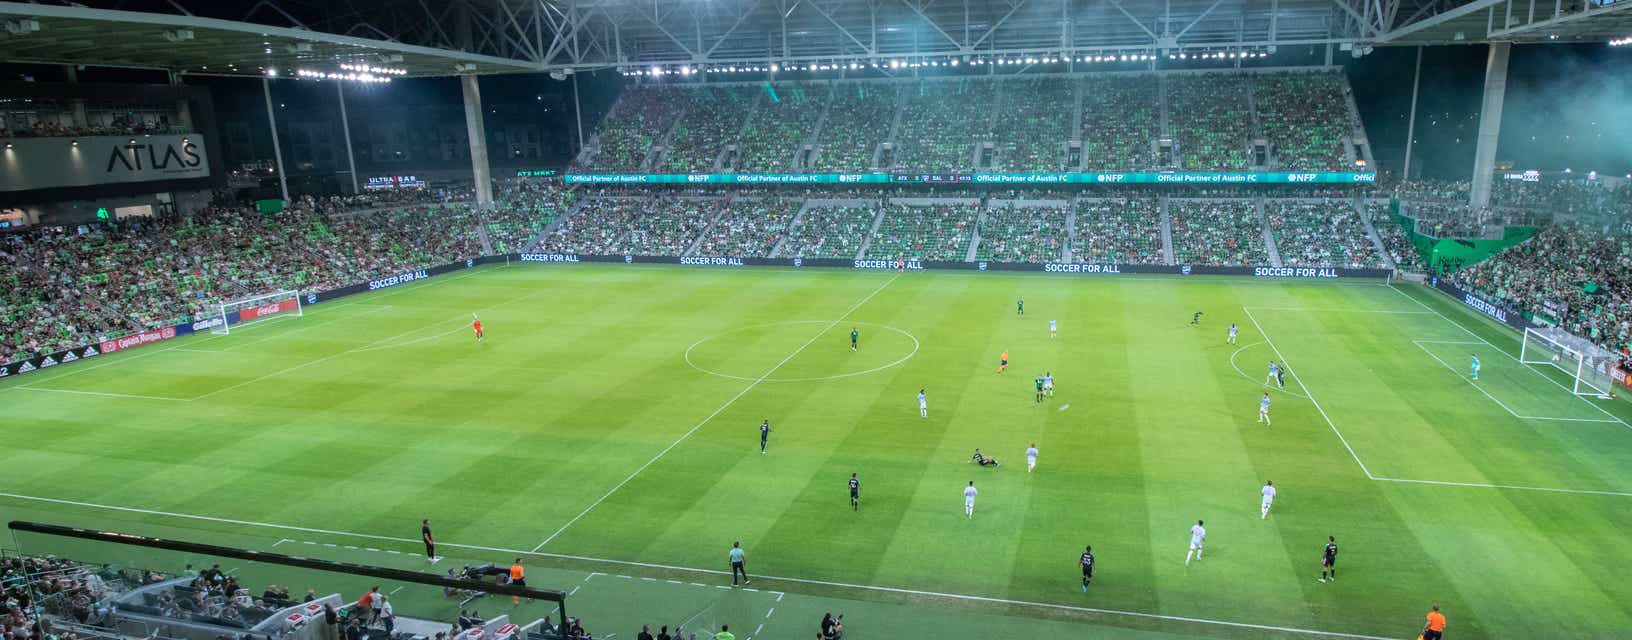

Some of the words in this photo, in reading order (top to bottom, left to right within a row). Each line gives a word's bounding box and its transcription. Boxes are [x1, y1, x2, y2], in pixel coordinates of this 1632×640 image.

[107, 143, 201, 172] ATLAS
[1158, 174, 1183, 182] Official
[1185, 174, 1211, 182] Partner
[1212, 174, 1221, 182] of
[1221, 174, 1246, 182] Austin
[1247, 174, 1257, 182] FC
[1297, 174, 1317, 182] NFP
[521, 253, 548, 261] SOCCER
[549, 254, 564, 262] FOR
[565, 254, 580, 262] ALL
[711, 257, 727, 265] FOR
[854, 260, 887, 268] SOCCER
[907, 261, 923, 269] ALL
[1045, 264, 1080, 272] SOCCER
[1082, 264, 1101, 272] FOR
[1102, 264, 1121, 273] ALL
[1255, 267, 1294, 276] SOCCER
[1295, 268, 1316, 277] FOR
[1318, 268, 1338, 277] ALL
[369, 276, 399, 290] SOCCER
[399, 272, 414, 283] FOR
[414, 270, 428, 280] ALL
[1465, 293, 1485, 311] SOCCER
[1484, 302, 1496, 317] FOR
[1495, 308, 1507, 323] ALL
